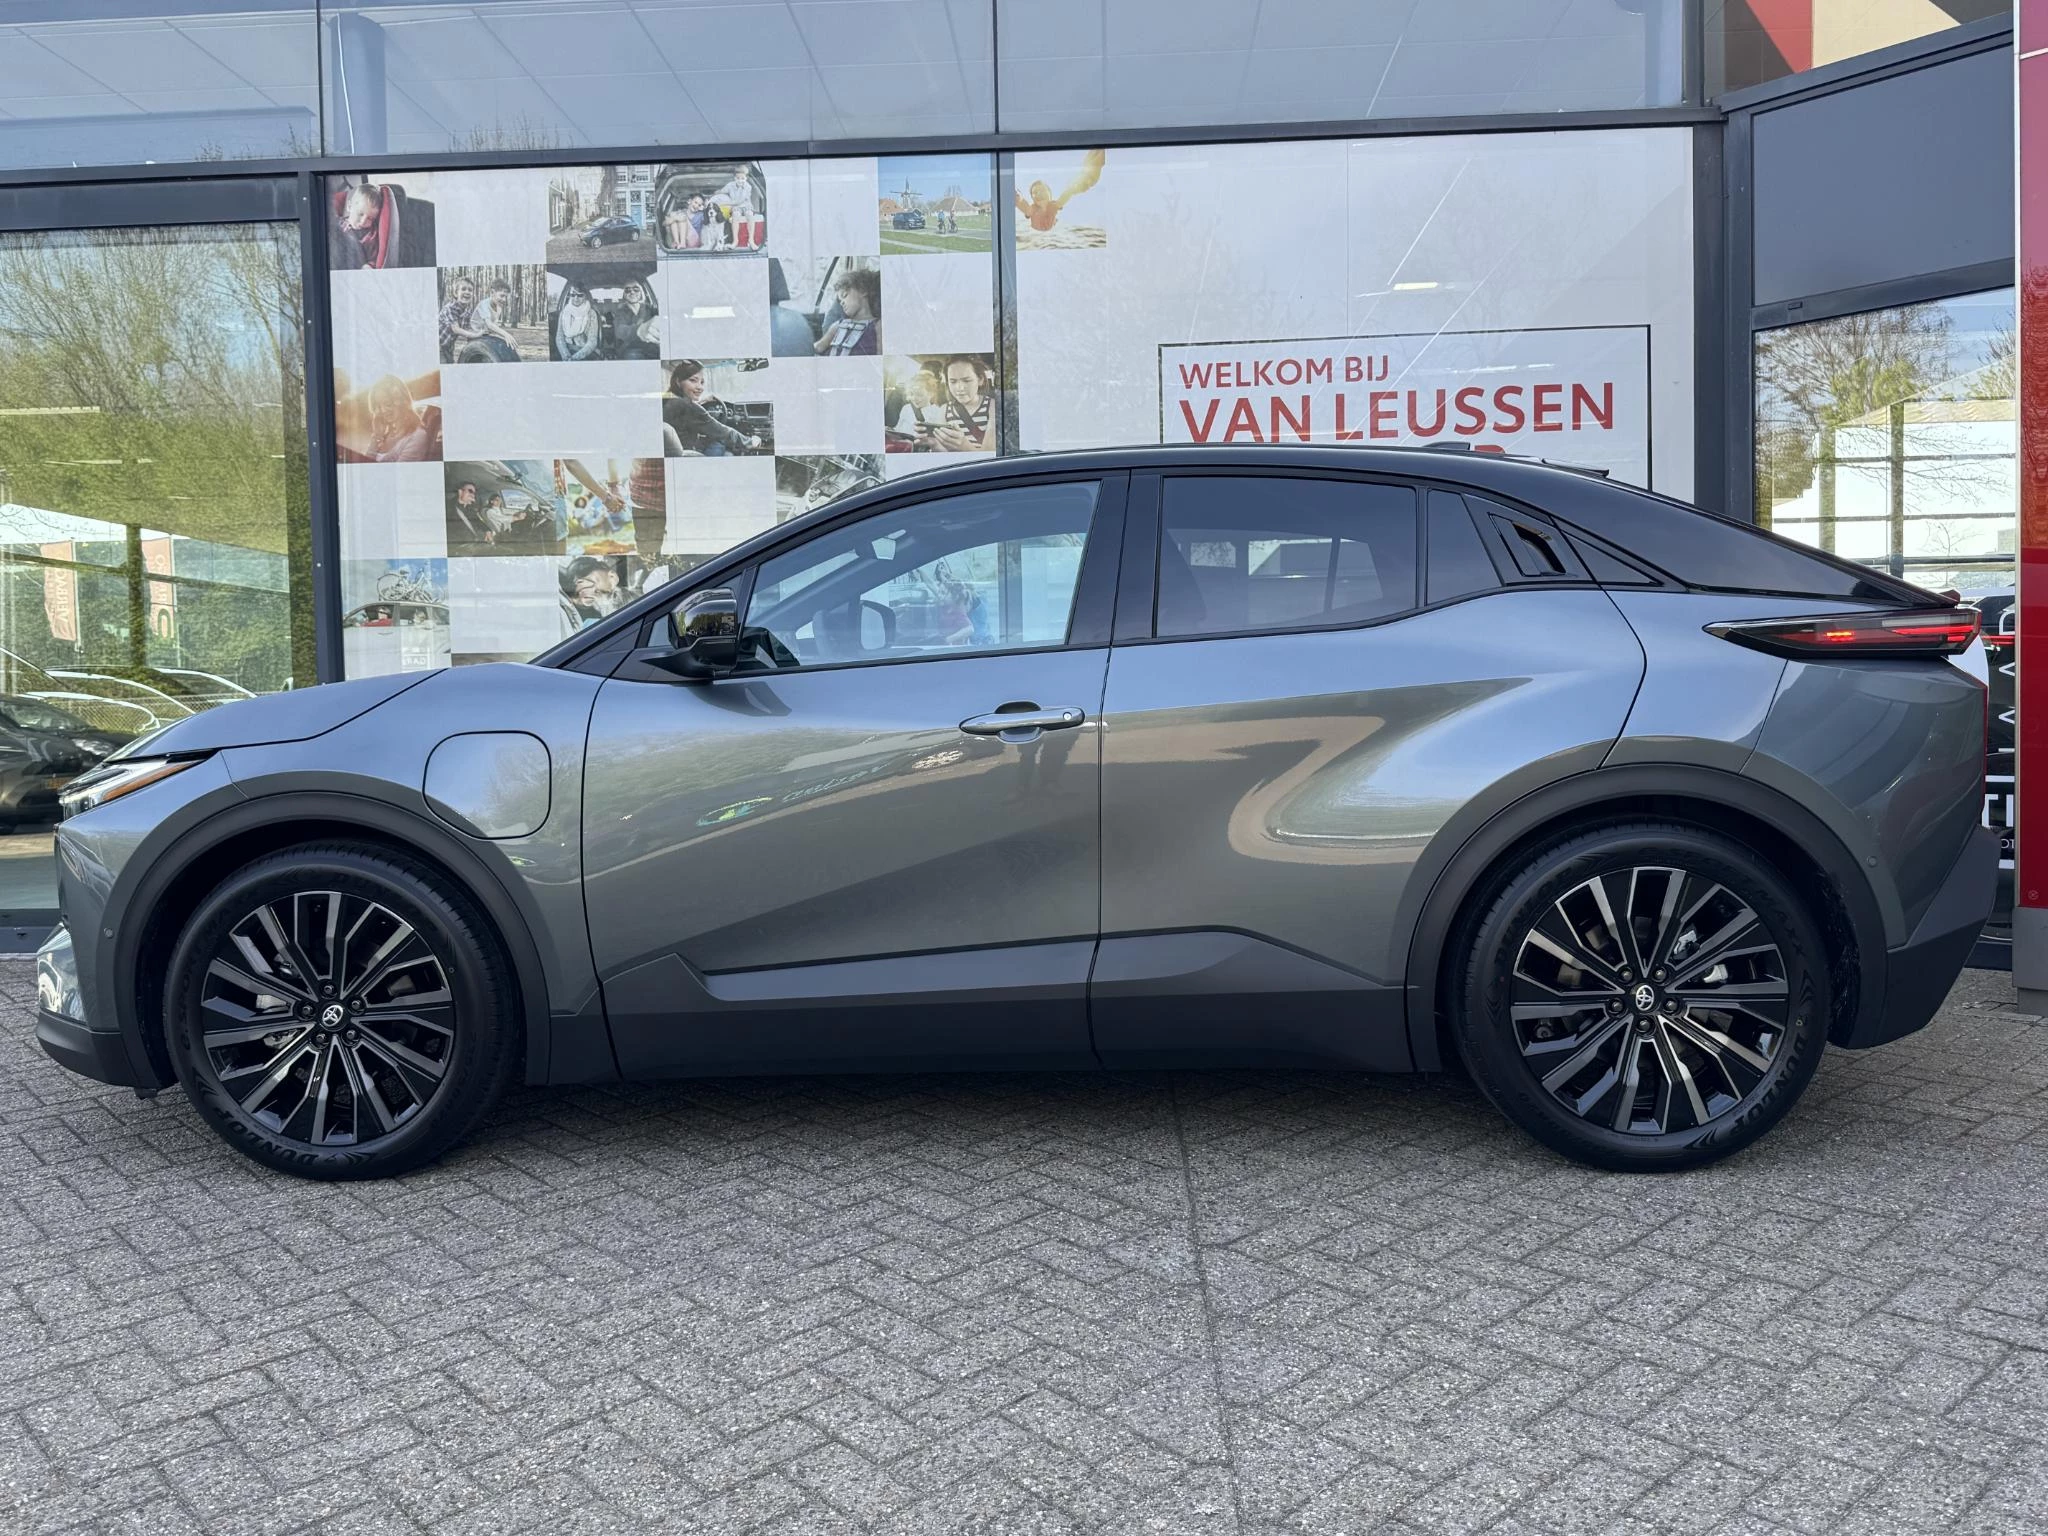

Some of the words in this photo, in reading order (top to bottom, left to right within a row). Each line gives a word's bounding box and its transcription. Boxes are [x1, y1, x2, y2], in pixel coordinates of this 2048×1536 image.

[1179, 357, 1333, 389] WELKOM
[1344, 354, 1389, 382] BIJ
[1179, 394, 1311, 443] VAN
[1335, 382, 1614, 440] LEUSSEN
[1730, 1034, 1807, 1136] DUNLOP
[213, 1106, 320, 1167] DUNLOP
